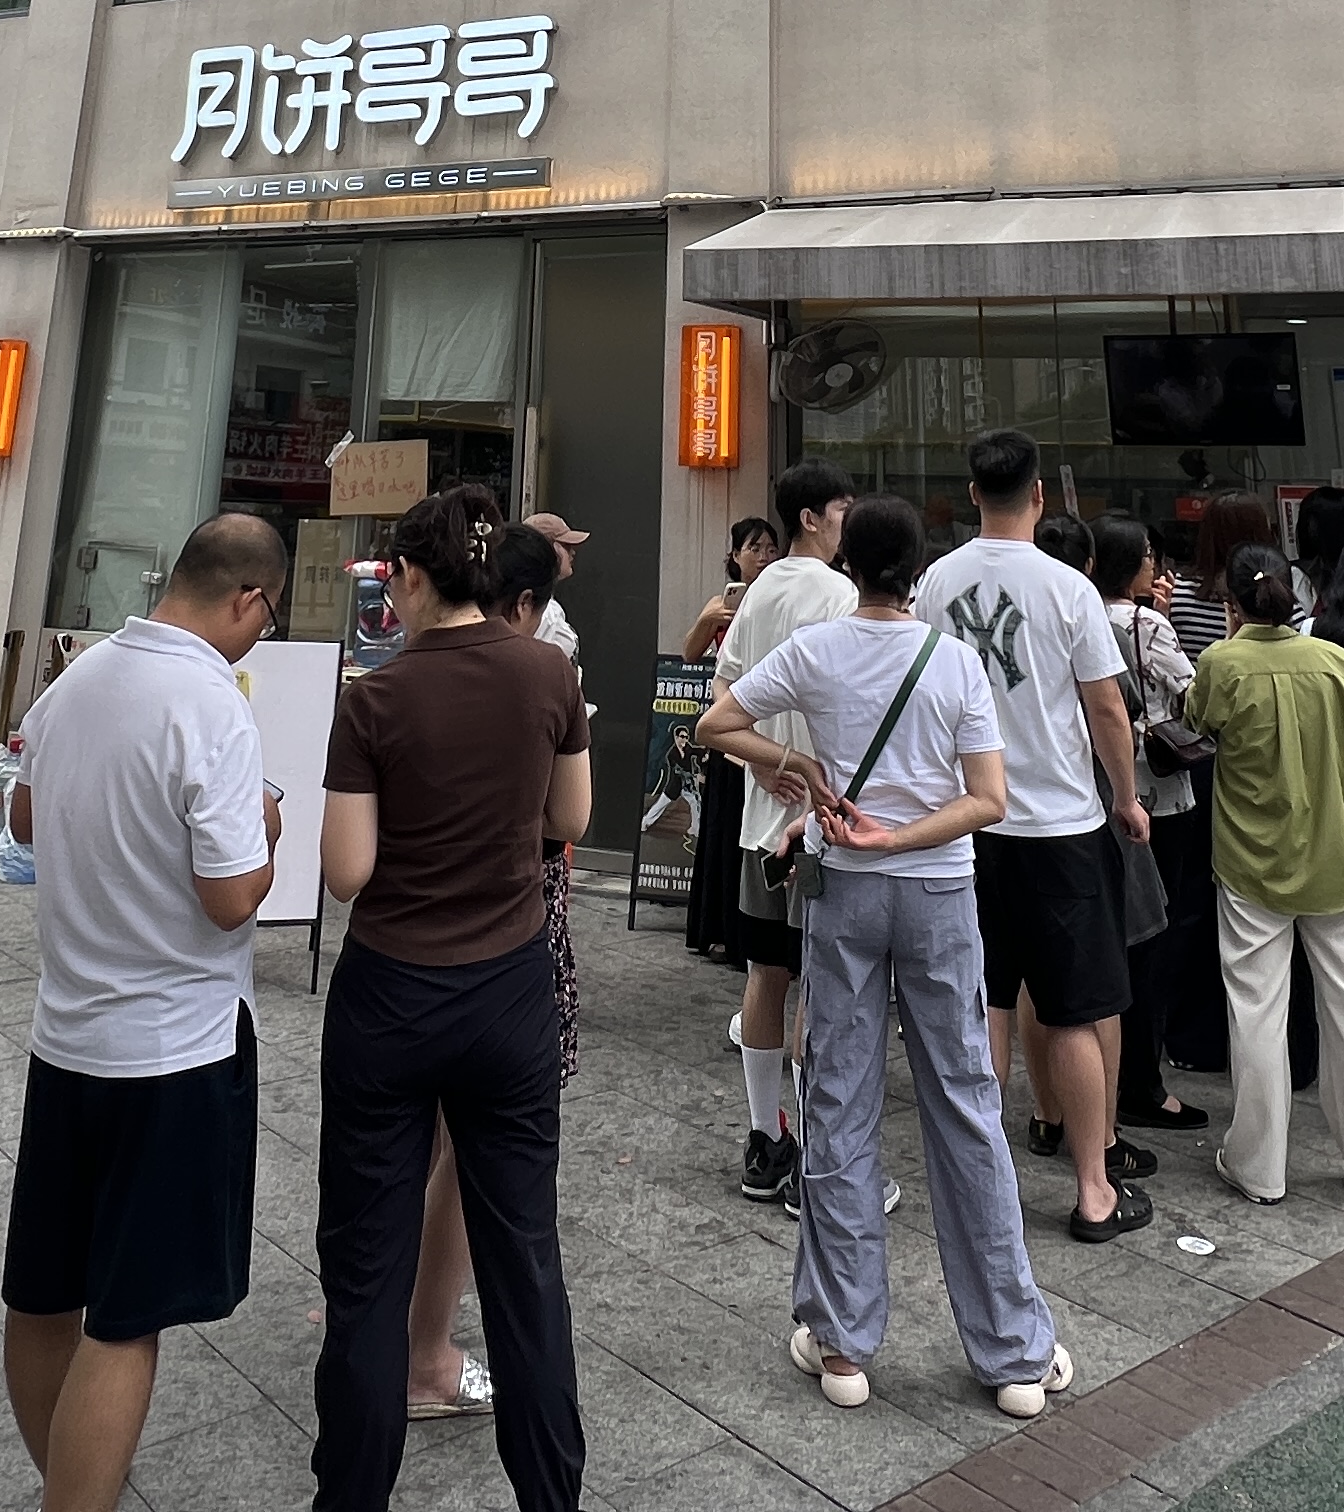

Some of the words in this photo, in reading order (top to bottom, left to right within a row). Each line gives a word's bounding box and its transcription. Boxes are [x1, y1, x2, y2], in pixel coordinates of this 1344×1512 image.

[171, 15, 554, 162] 月饼哥哥
[217, 175, 364, 198] YUEBING
[384, 167, 488, 188] GEGE
[693, 331, 717, 460] 月饼哥哥
